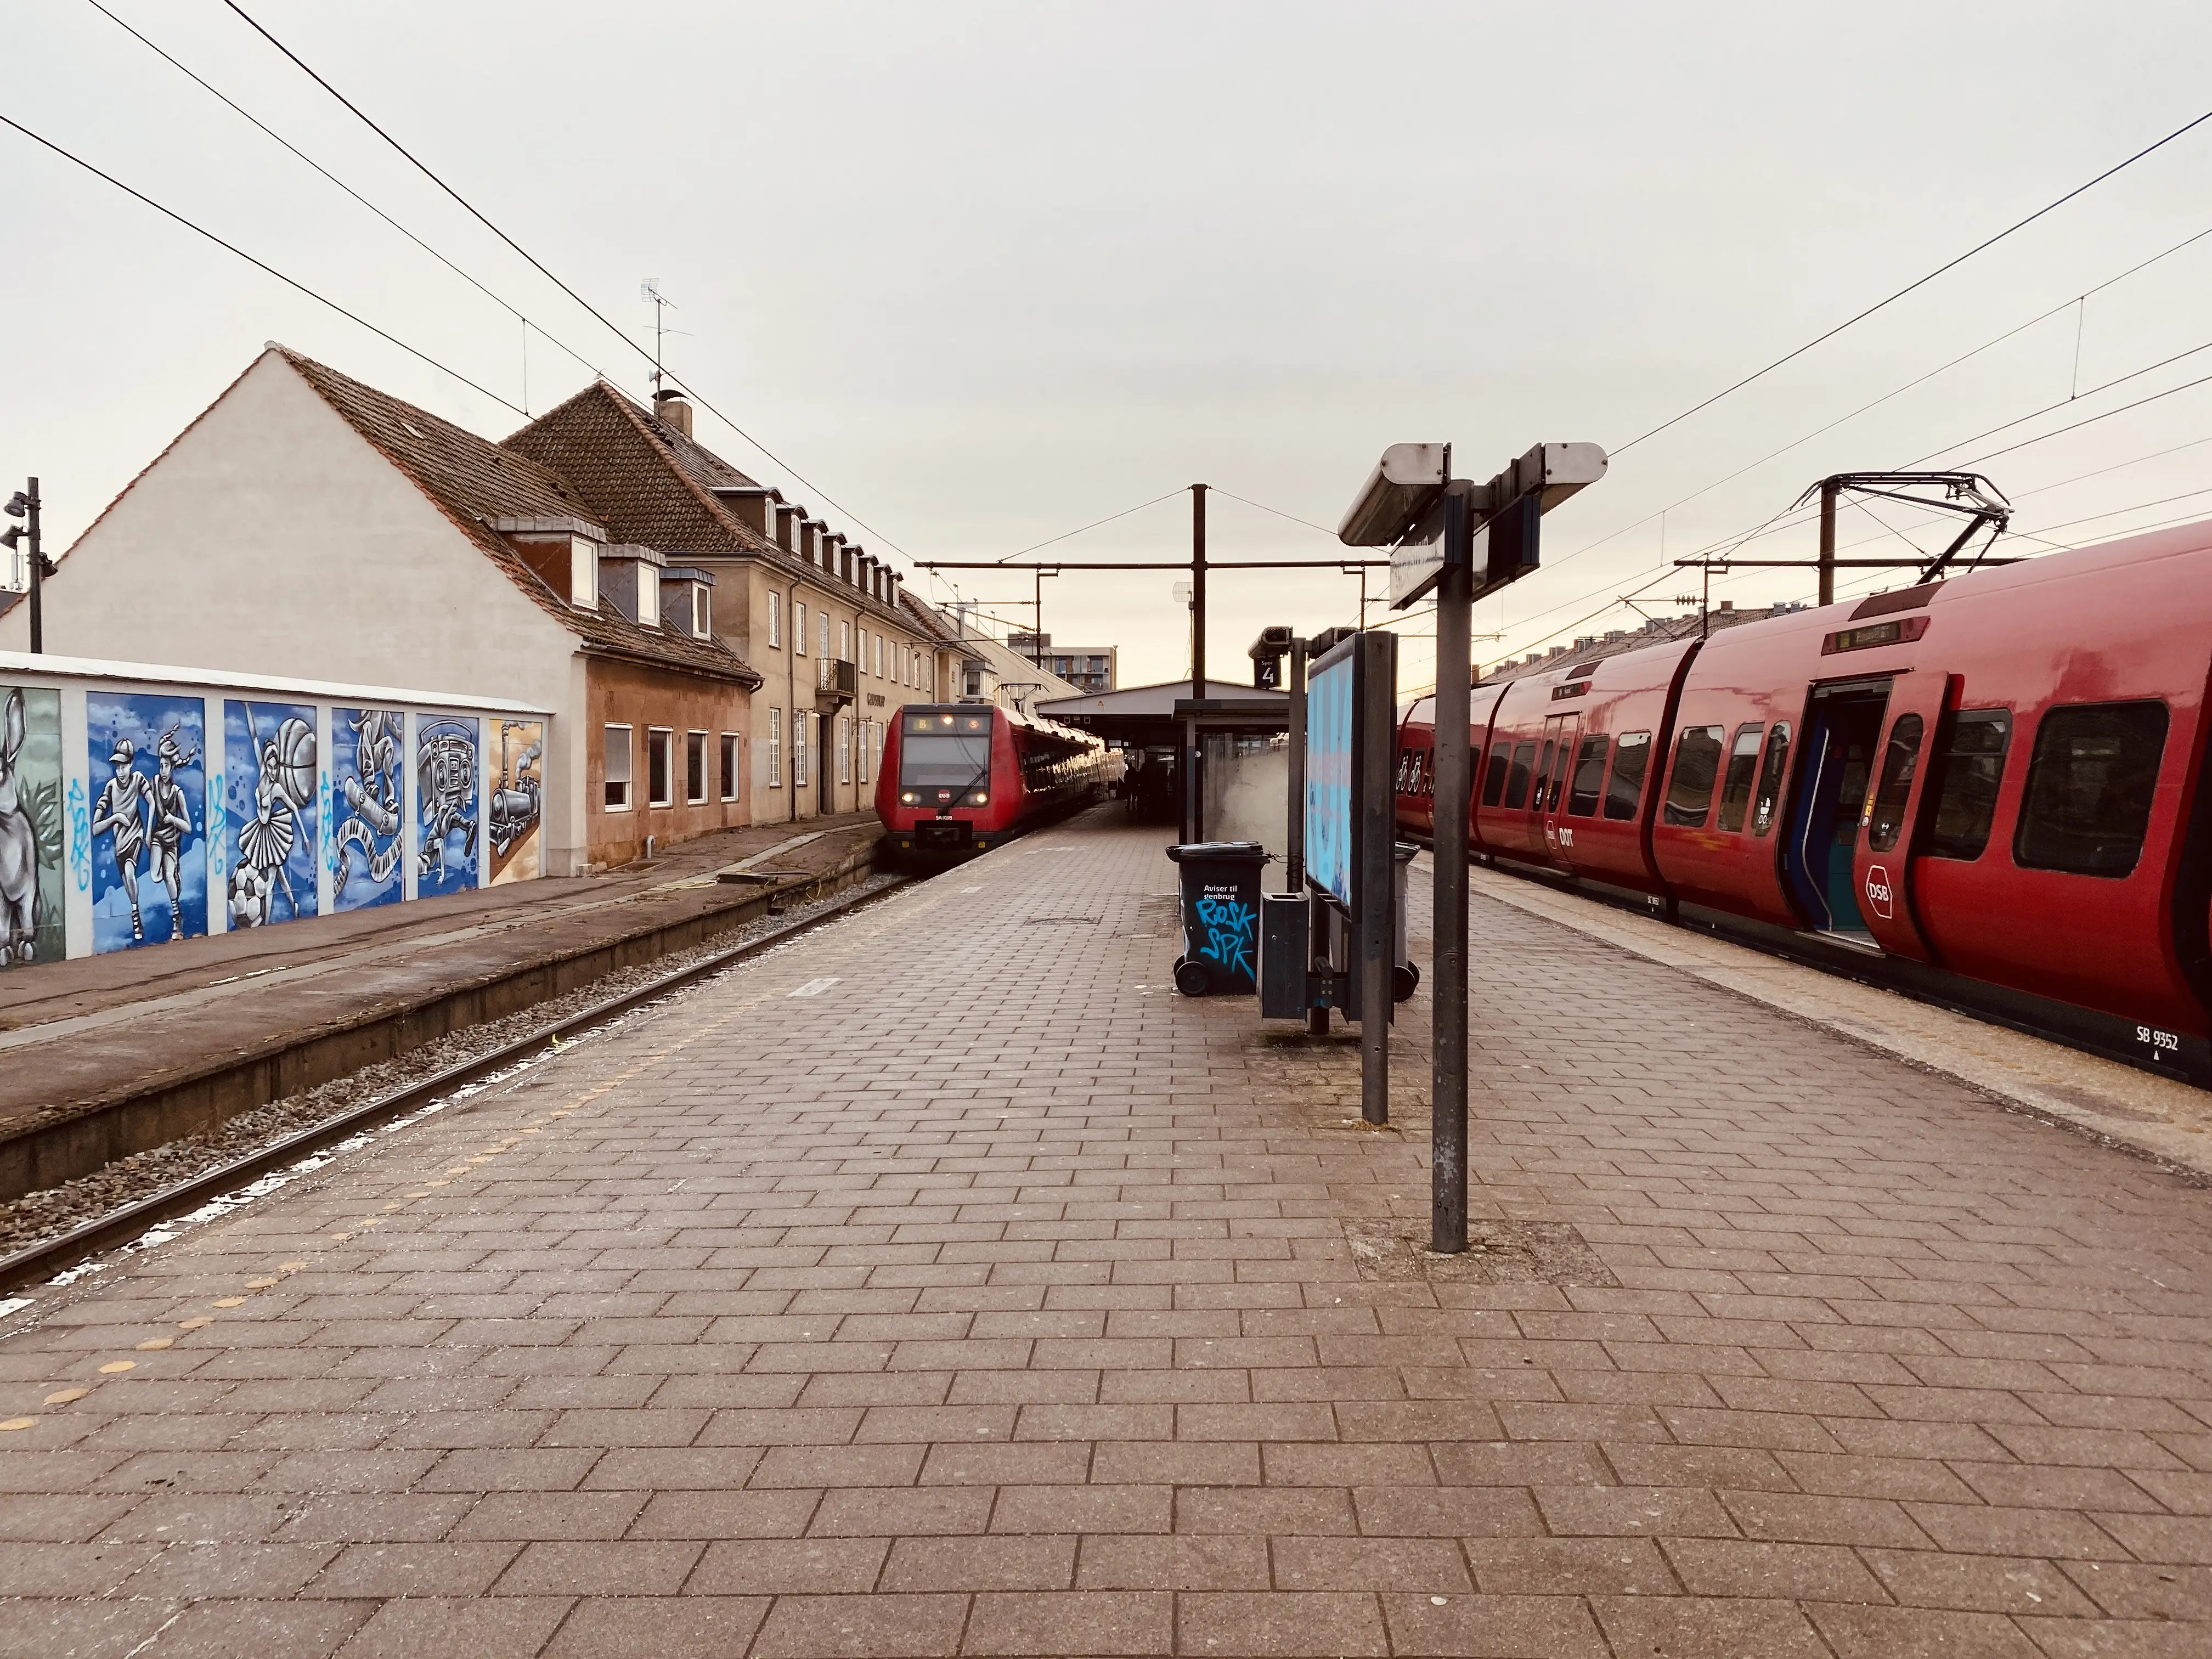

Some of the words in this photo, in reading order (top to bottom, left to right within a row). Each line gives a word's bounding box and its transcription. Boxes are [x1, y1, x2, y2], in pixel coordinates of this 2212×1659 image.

[1262, 667, 1274, 683] 4
[919, 719, 927, 729] B
[969, 720, 979, 729] S
[1559, 827, 1574, 847] DOT
[1869, 882, 1889, 901] DSB
[2137, 1026, 2150, 1042] SB
[2153, 1030, 2179, 1051] 9352
